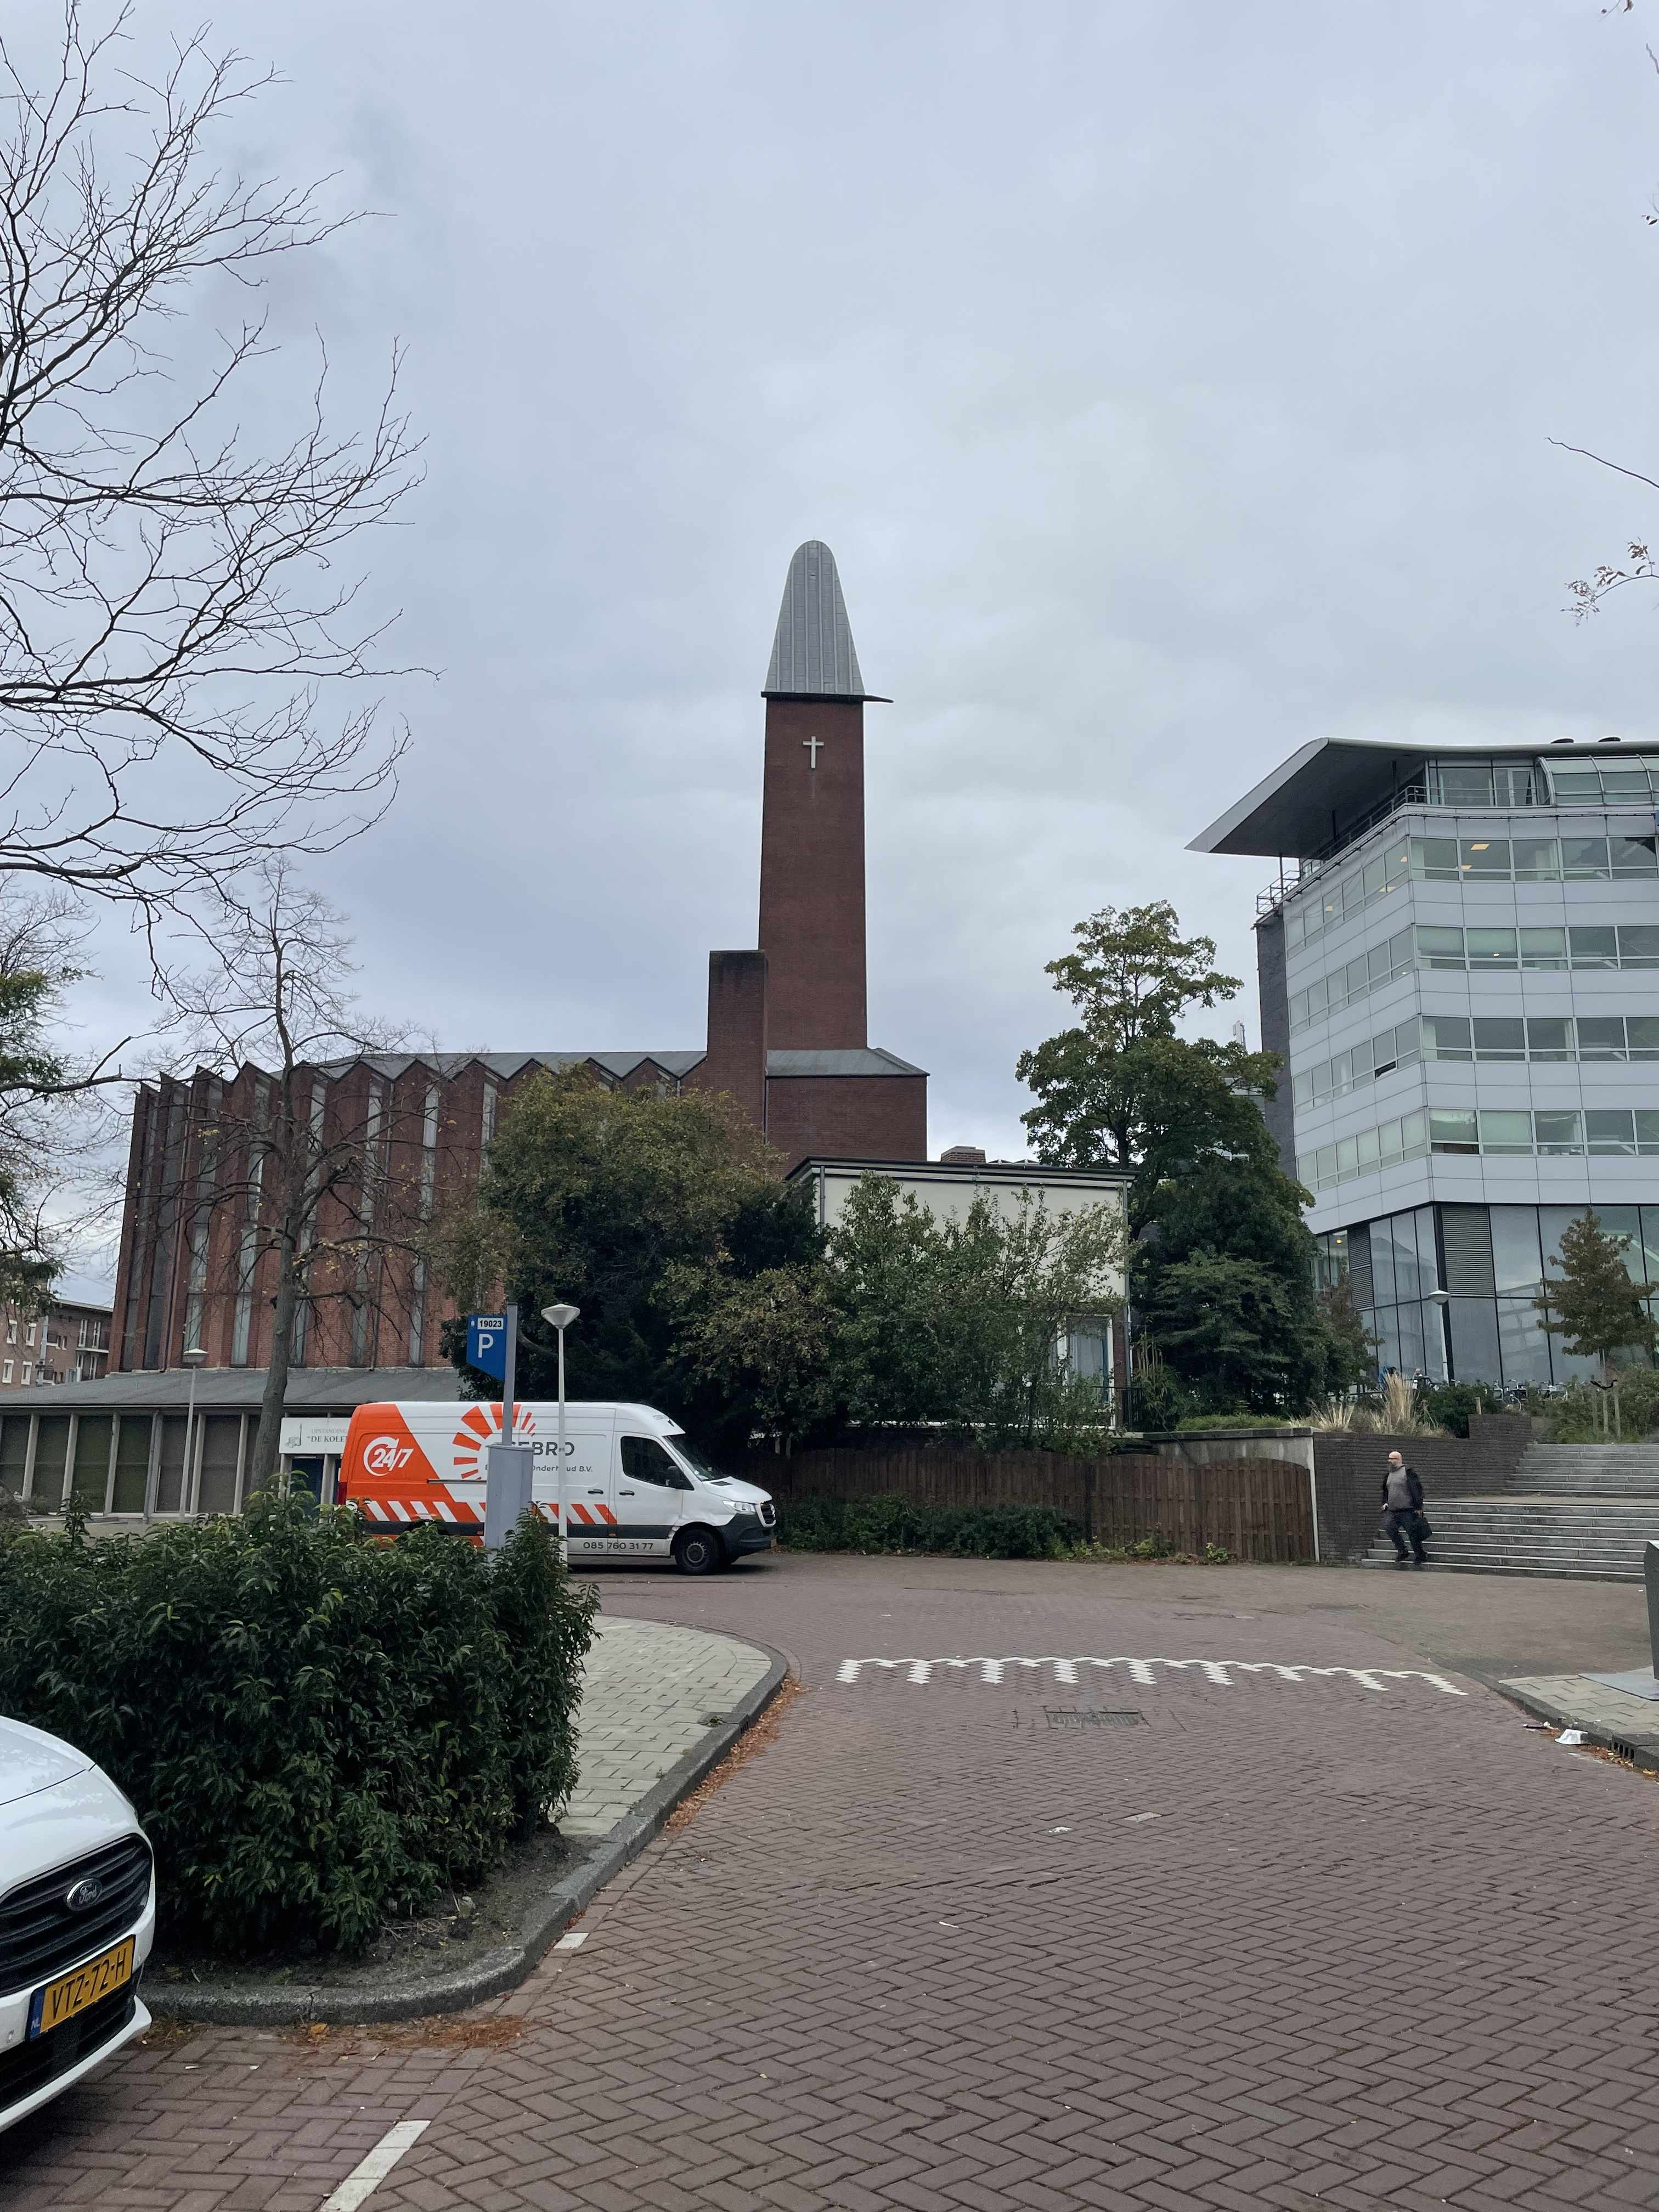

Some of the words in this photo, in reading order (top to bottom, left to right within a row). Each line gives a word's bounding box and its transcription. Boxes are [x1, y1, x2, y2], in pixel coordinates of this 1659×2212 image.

[478, 1333, 494, 1358] P
[371, 1448, 414, 1471] 24/7
[78, 1883, 97, 1904] Ford
[53, 1946, 127, 2019] VTZ-72-H
[31, 2018, 41, 2032] NL
